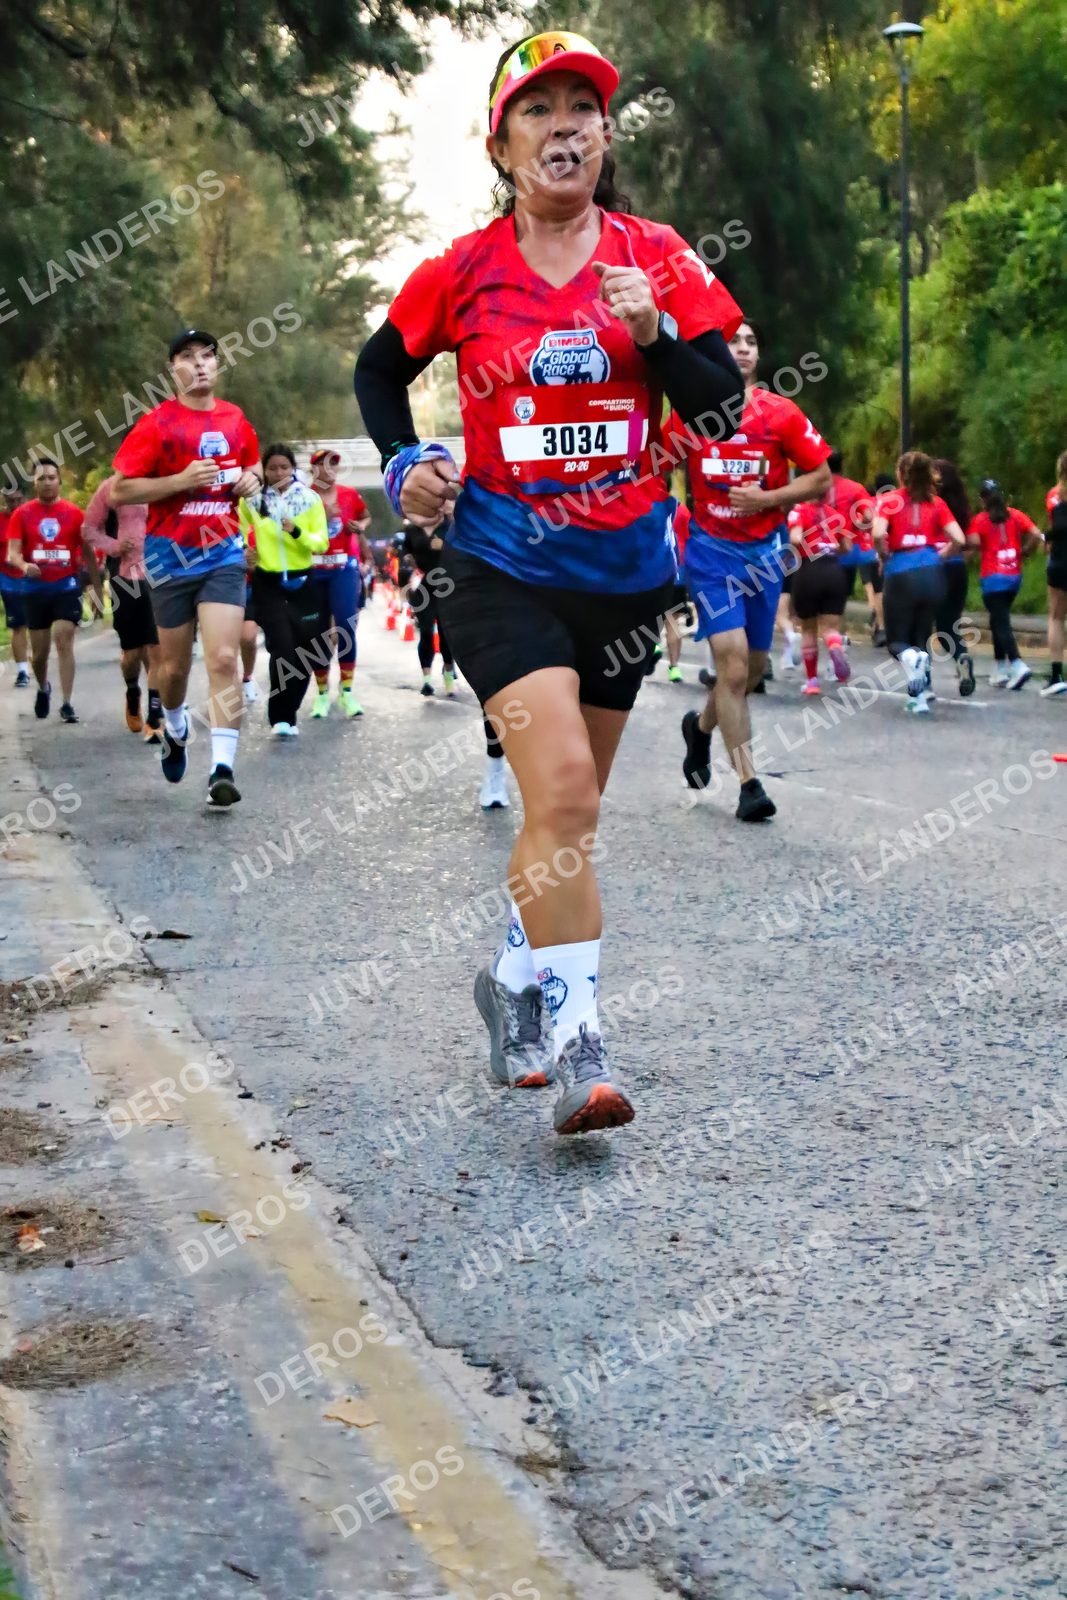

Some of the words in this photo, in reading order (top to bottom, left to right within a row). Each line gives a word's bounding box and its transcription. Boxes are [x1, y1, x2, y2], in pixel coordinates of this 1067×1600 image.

[549, 337, 590, 347] BIMBO
[550, 350, 591, 364] Global
[542, 363, 575, 377] Race
[542, 424, 608, 456] 3034
